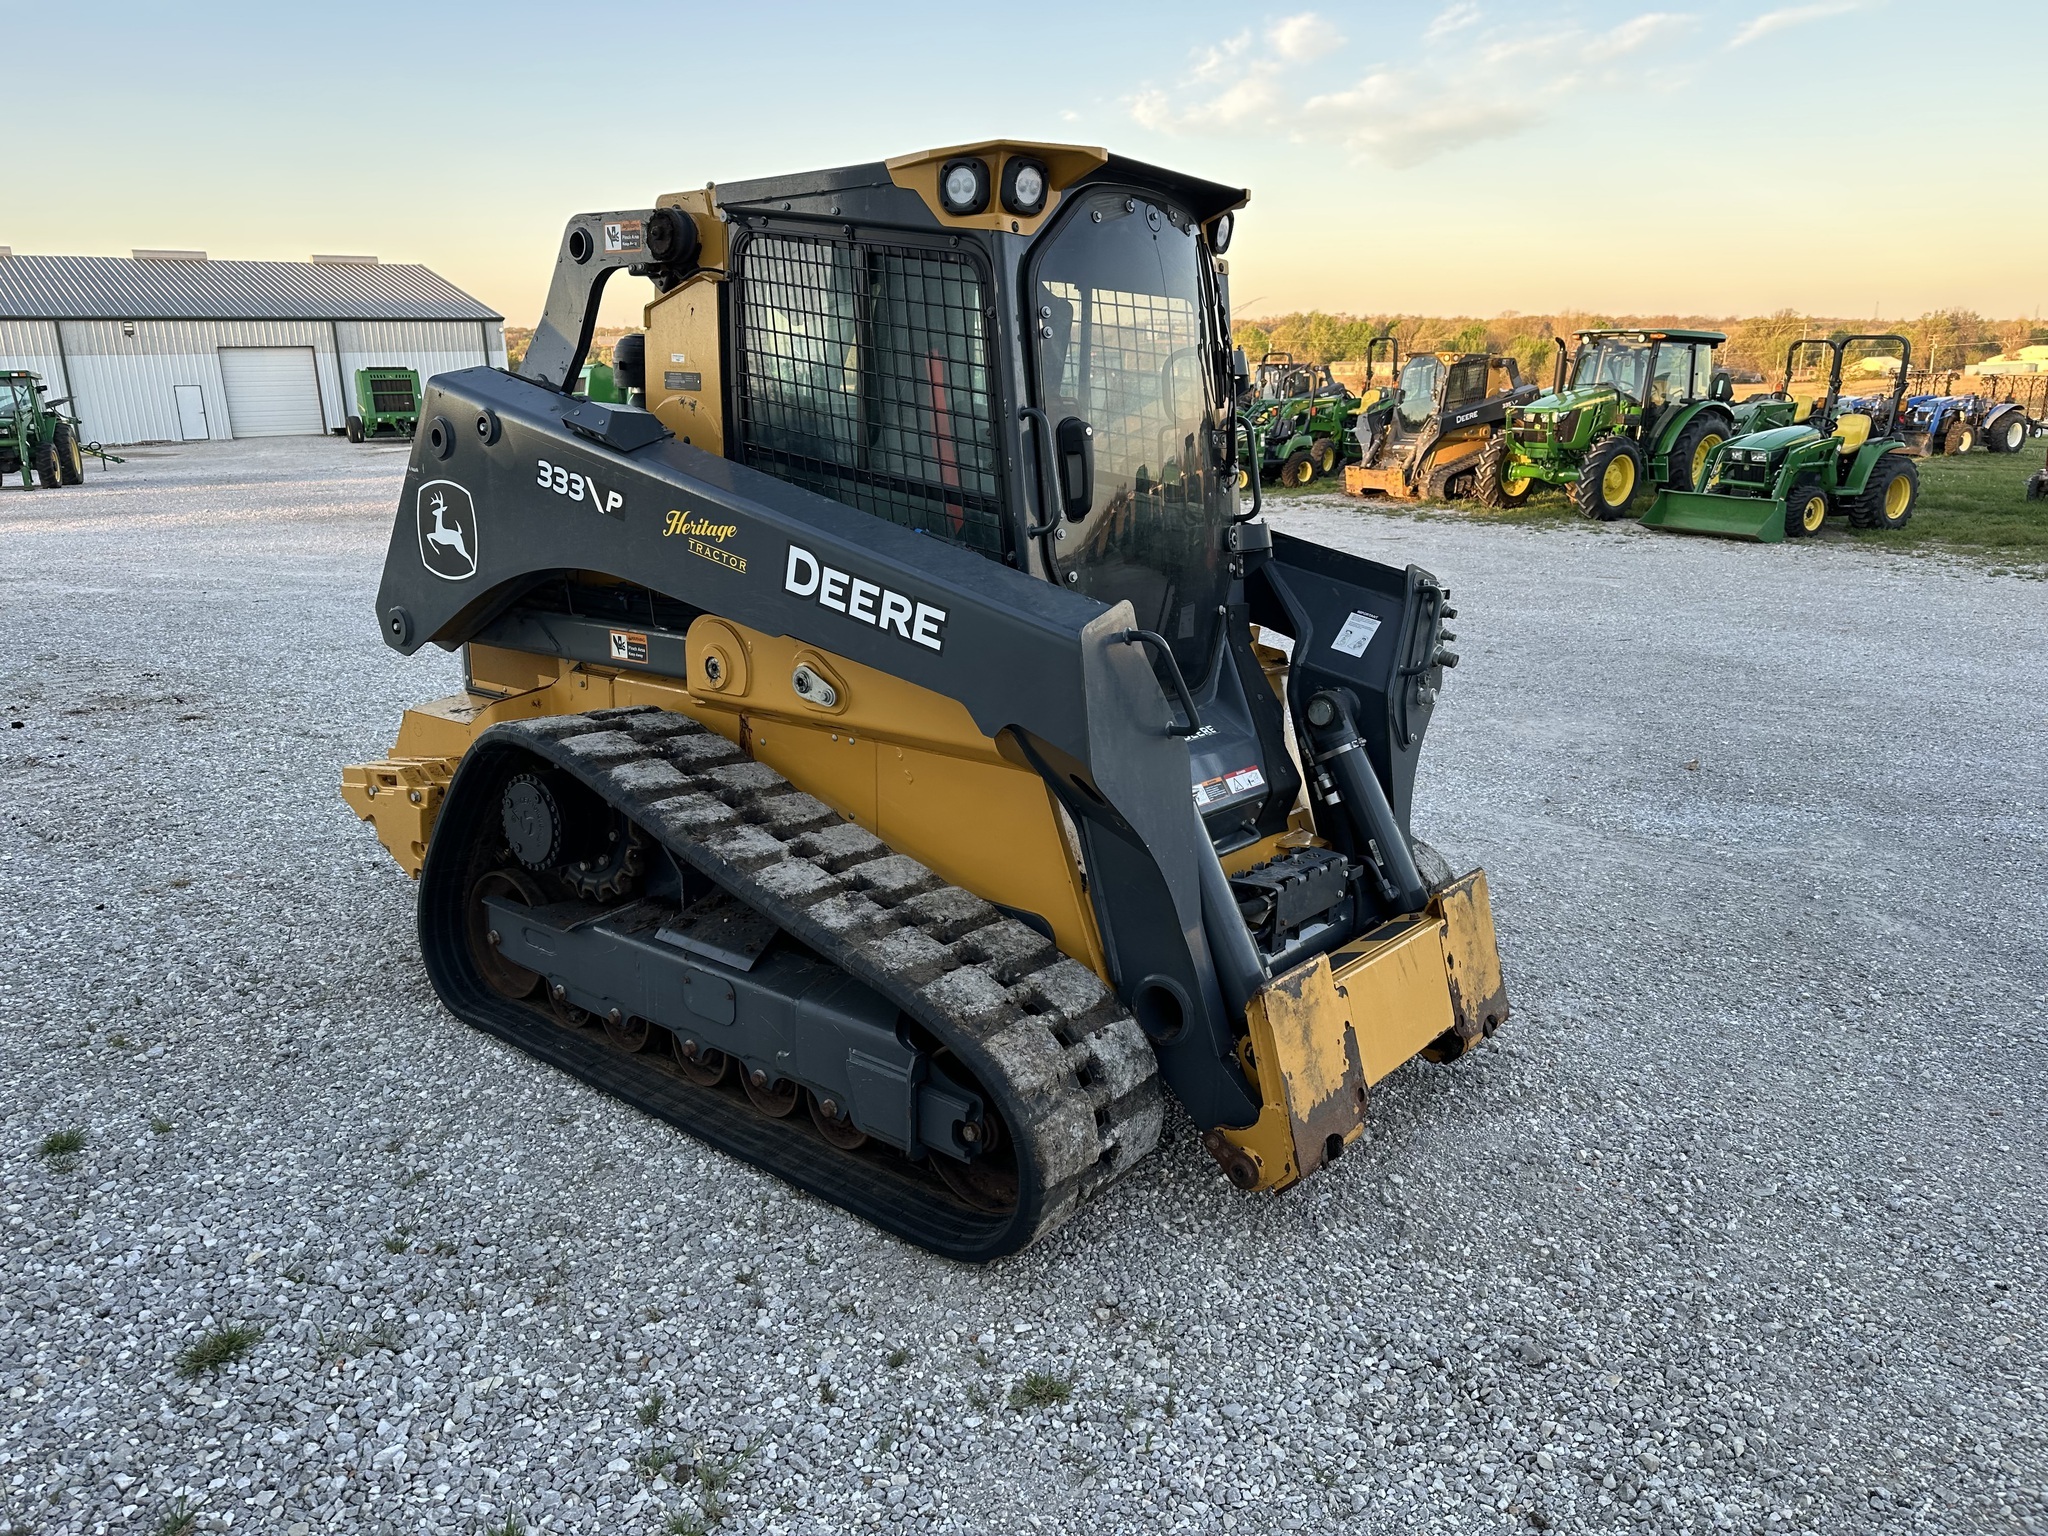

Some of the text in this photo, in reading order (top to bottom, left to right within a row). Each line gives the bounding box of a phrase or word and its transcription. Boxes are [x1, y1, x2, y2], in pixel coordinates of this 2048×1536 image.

[1456, 410, 1479, 424] DEERE
[662, 509, 738, 543] Heritage
[688, 540, 747, 572] TRACTOR
[784, 544, 947, 651] DEERE
